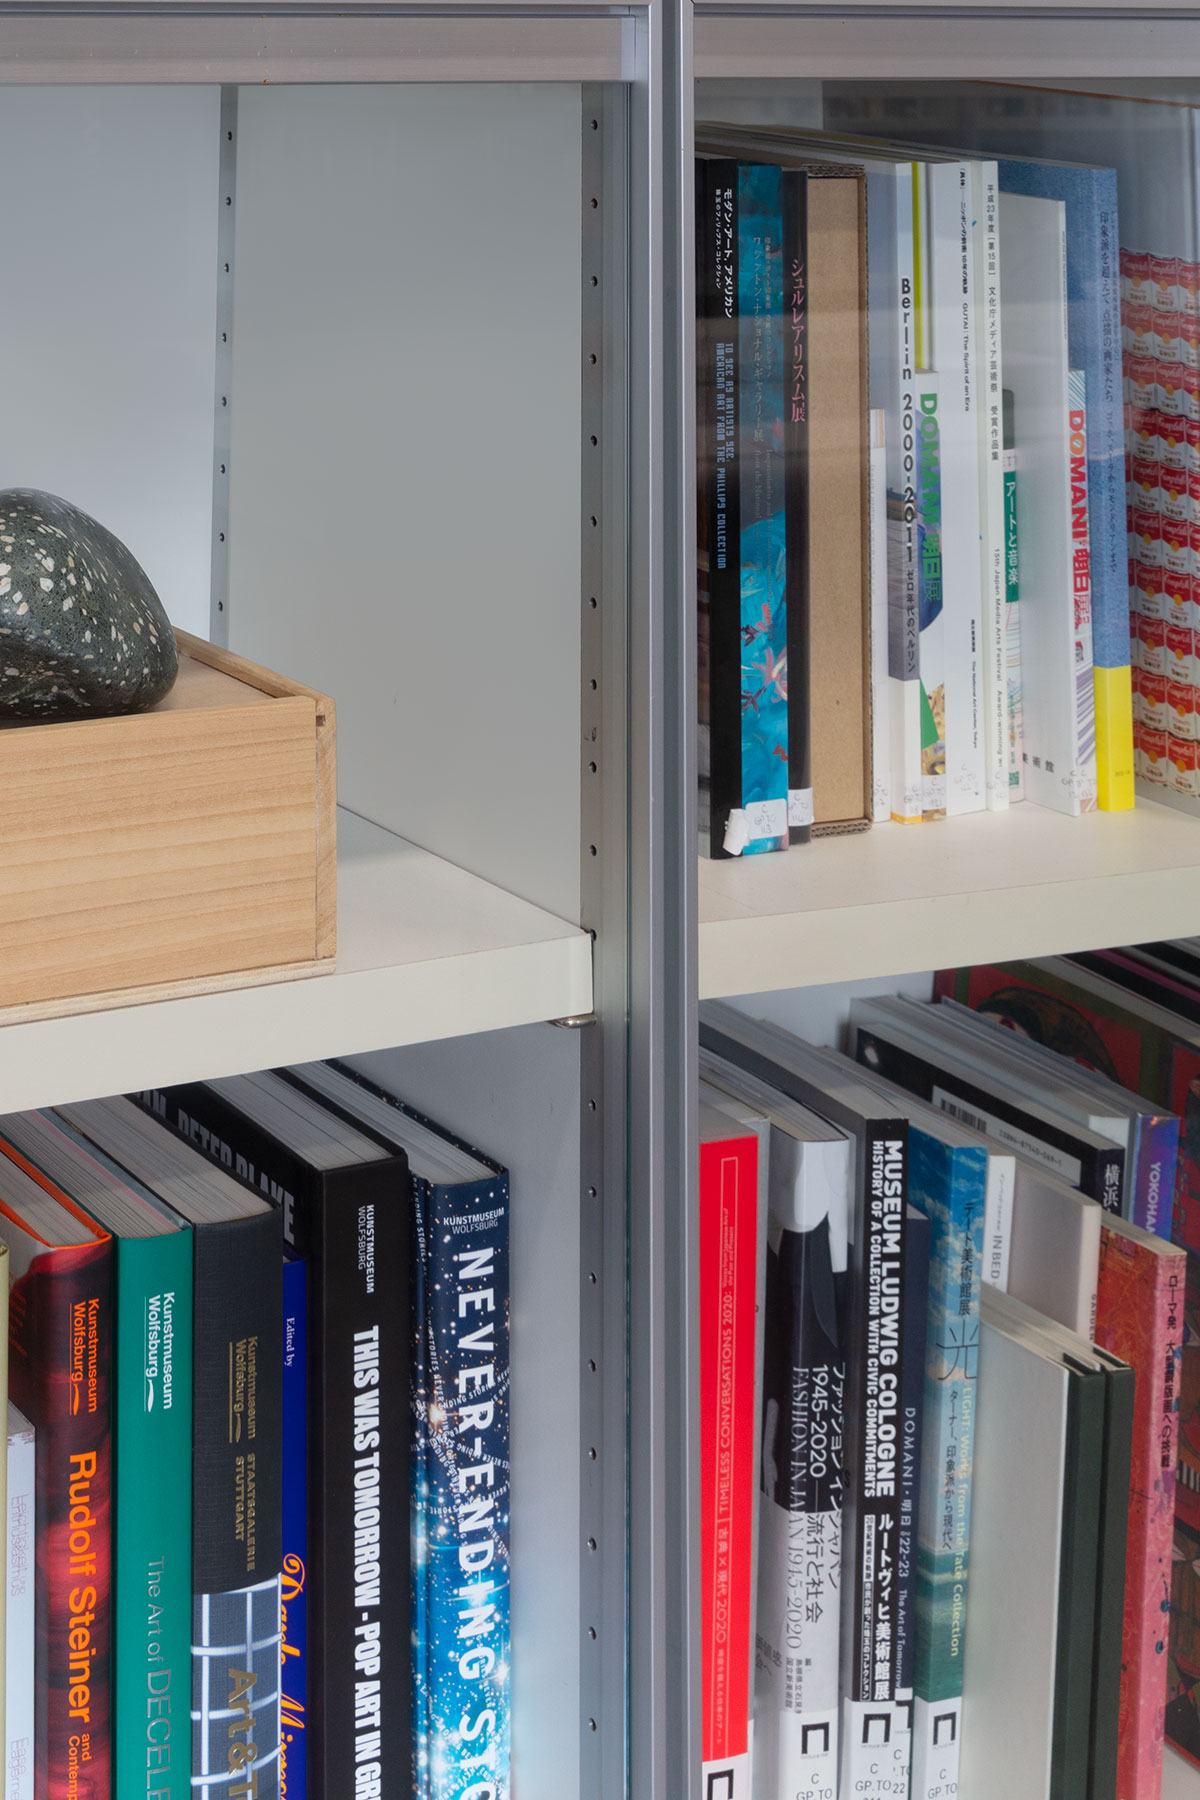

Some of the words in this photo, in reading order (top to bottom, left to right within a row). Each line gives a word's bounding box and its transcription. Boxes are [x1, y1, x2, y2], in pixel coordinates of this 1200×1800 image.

[790, 259, 805, 422] シュルレアリスム展
[901, 277, 912, 379] Berlin
[902, 394, 915, 562] 2000-2011
[1006, 481, 1018, 585] アートと音楽
[882, 1140, 902, 1252] MUSEUM
[145, 1295, 159, 1377] Wolfsburg
[163, 1291, 174, 1409] Kunstmuseum
[353, 1325, 379, 1386] THIS
[879, 1261, 899, 1365] LUDWIG
[353, 1388, 379, 1449] WAS
[457, 1247, 495, 1678] NEVER-ENDING
[810, 1364, 828, 1477] 1945-2020
[876, 1373, 897, 1497] COLOGNE
[67, 1454, 97, 1575] Rudolf
[353, 1452, 380, 1606] TOMORROW
[806, 1514, 823, 1622] 流行と社会
[67, 1587, 96, 1722] Steiner
[354, 1626, 380, 1675] POP
[874, 1513, 892, 1700] ルートヴィヒ美術館展
[354, 1682, 380, 1731] ART
[354, 1737, 380, 1763] IN
